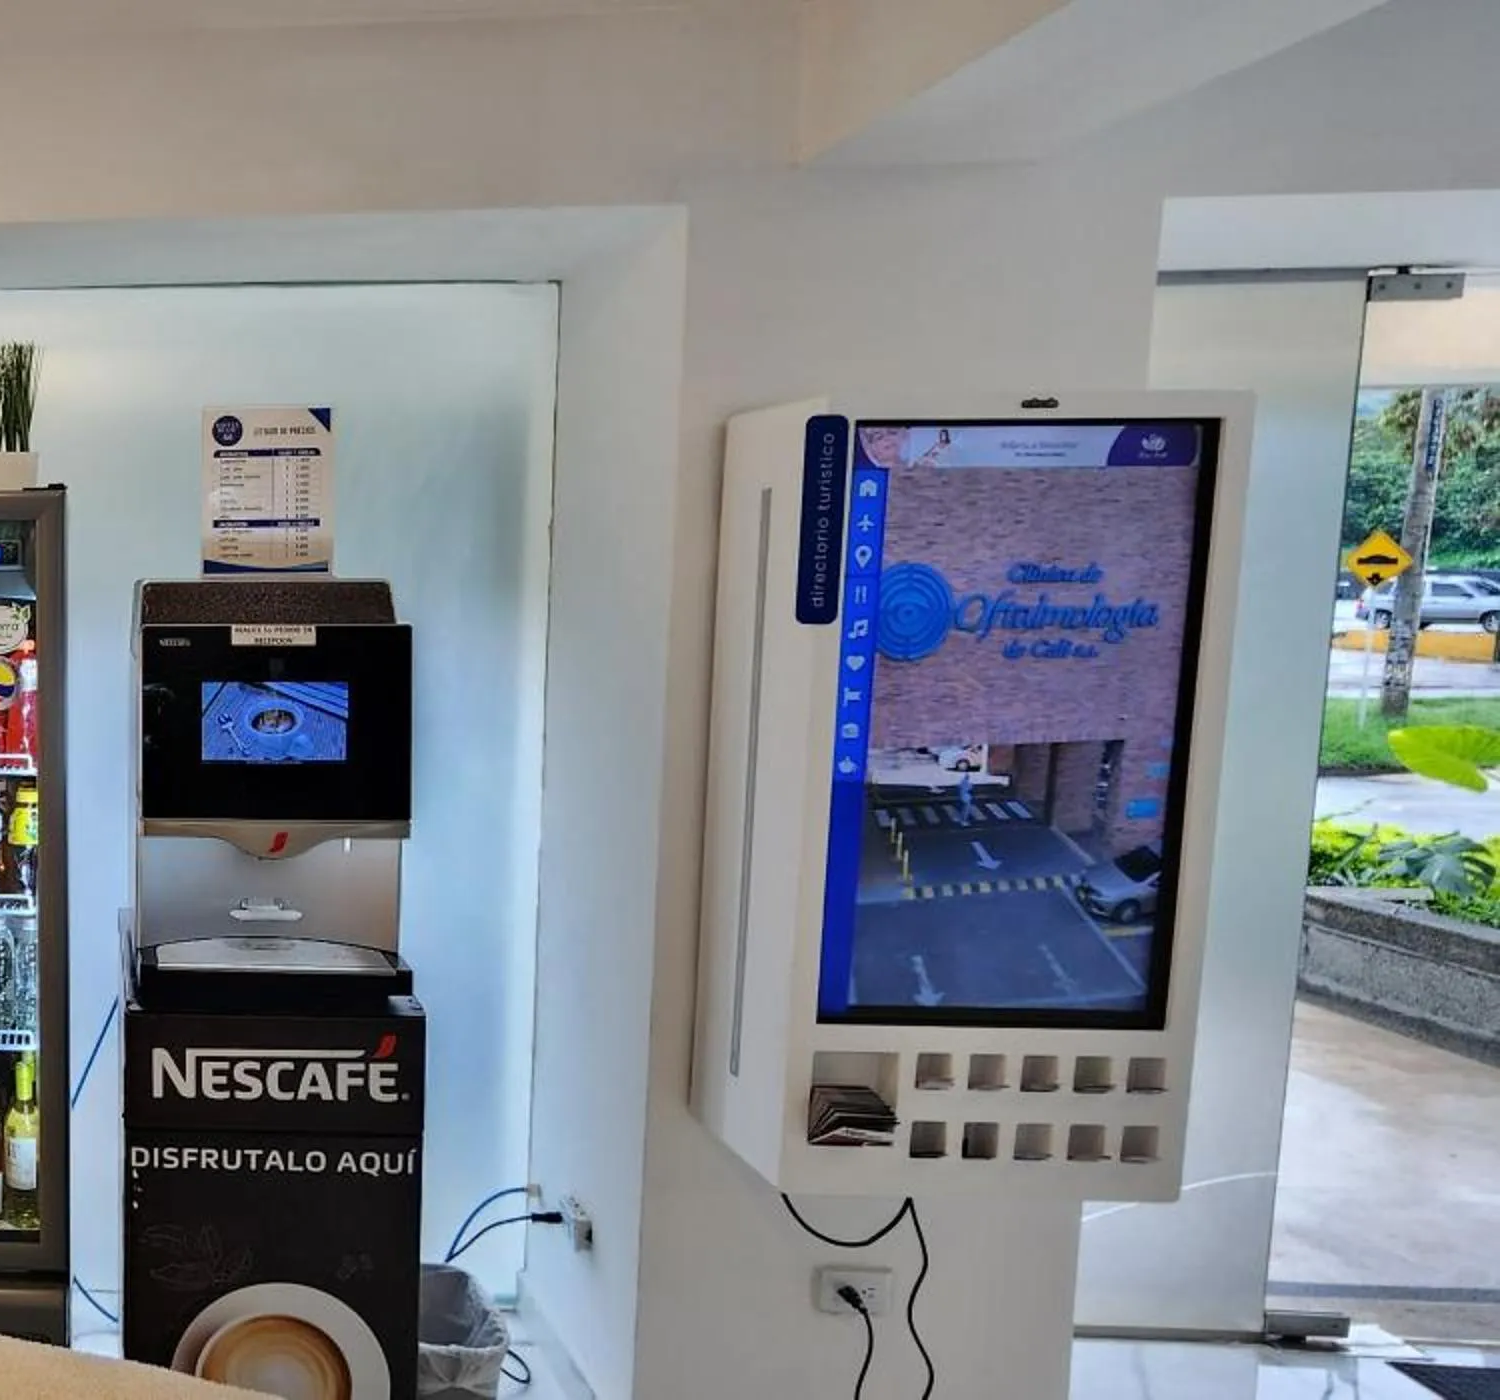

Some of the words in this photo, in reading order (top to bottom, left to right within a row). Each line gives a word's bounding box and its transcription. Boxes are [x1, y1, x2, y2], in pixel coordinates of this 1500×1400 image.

[812, 516, 830, 608] directorio
[130, 1146, 327, 1173] DISFRUTALO
[337, 1148, 417, 1177] AQUÍ
